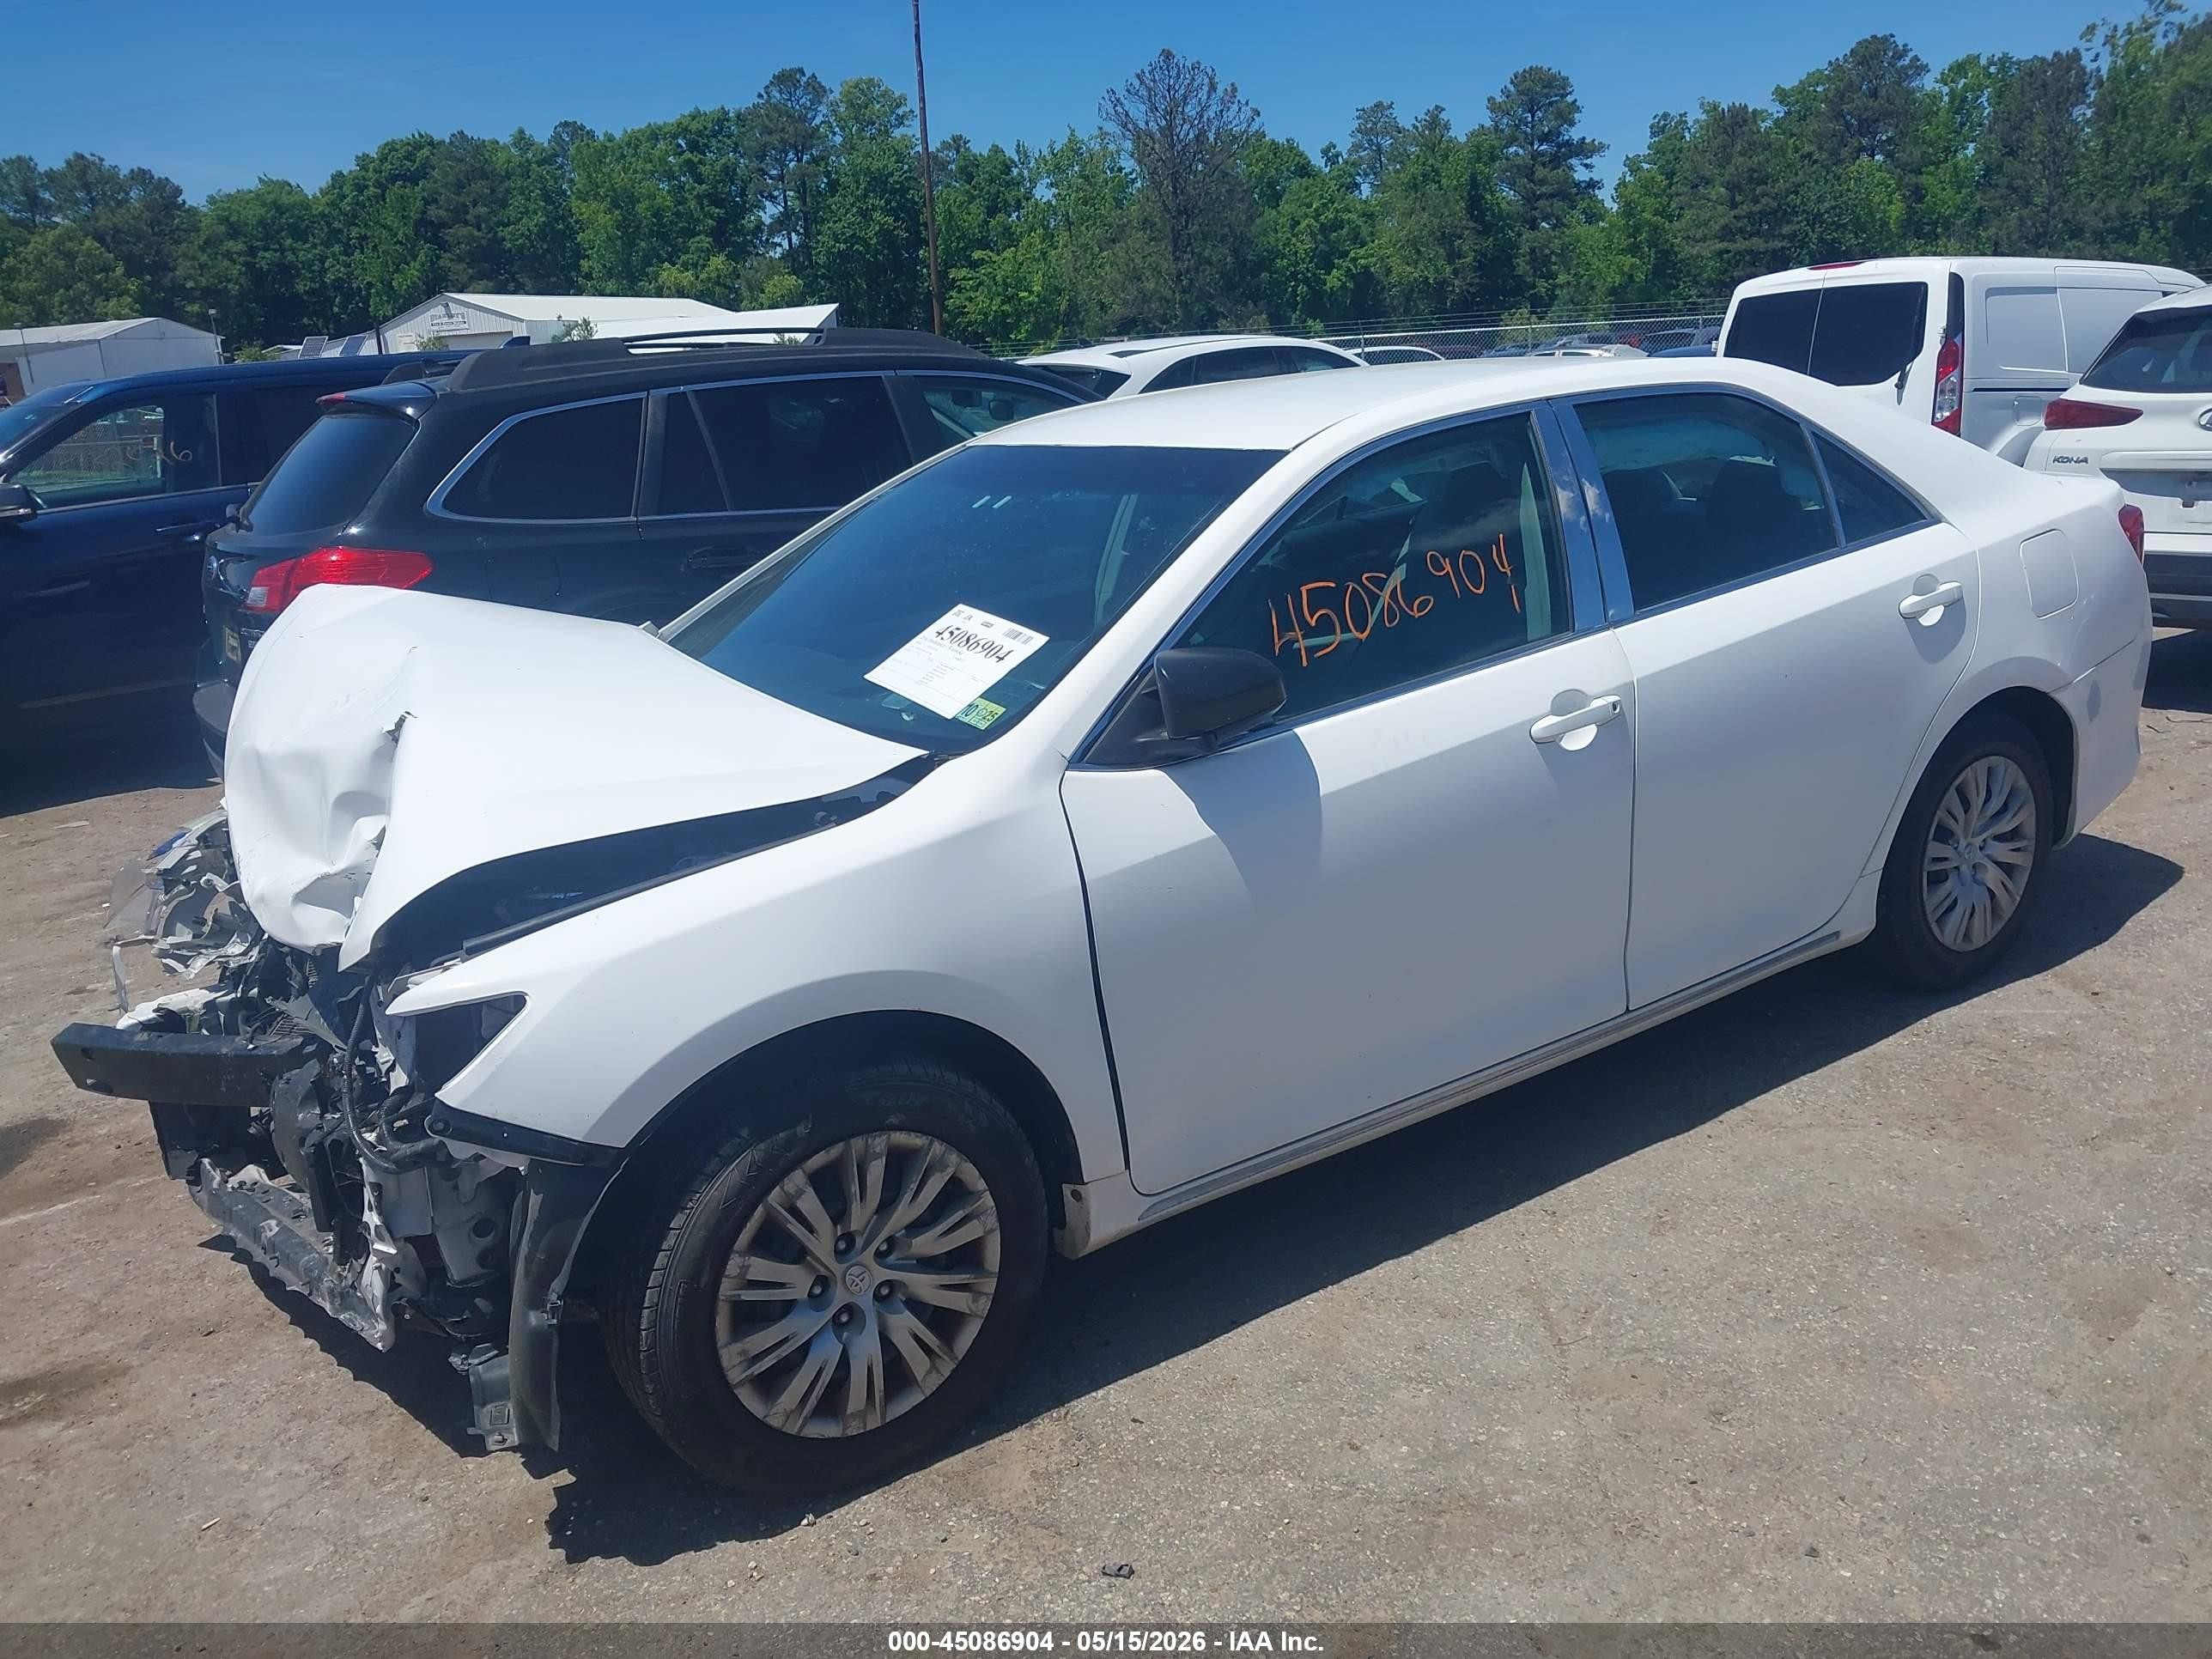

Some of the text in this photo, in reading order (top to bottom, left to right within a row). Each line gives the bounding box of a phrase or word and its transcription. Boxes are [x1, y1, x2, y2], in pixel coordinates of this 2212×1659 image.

[2053, 456, 2088, 465] KONA
[1268, 533, 1520, 666] 45086904
[936, 625, 1014, 663] 45086904
